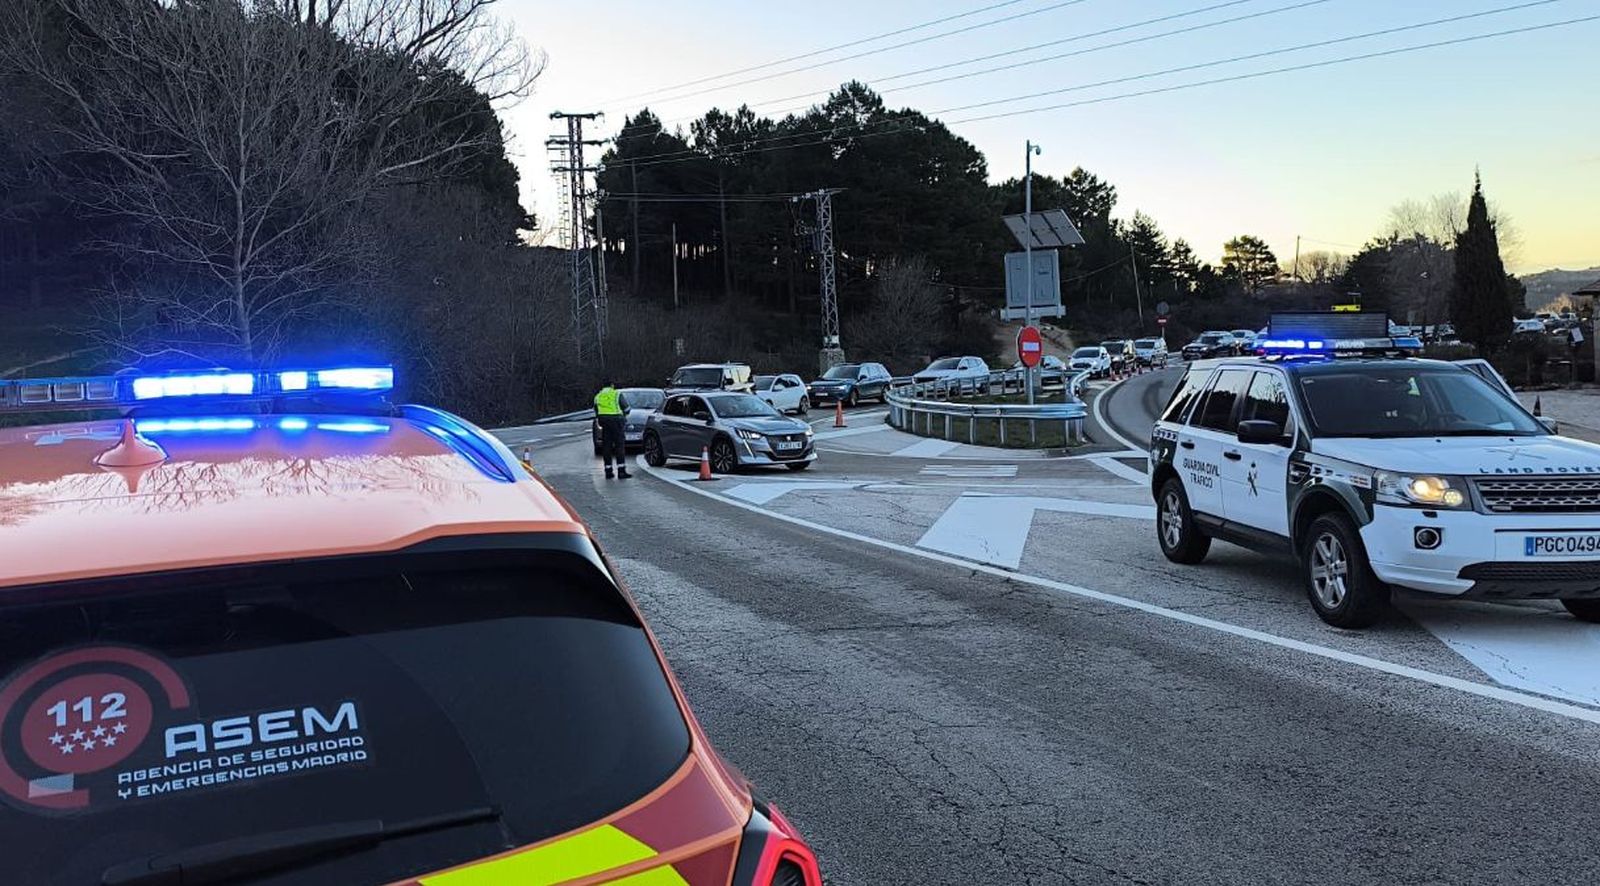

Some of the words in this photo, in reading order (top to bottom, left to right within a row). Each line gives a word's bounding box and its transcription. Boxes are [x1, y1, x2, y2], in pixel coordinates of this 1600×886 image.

[1183, 458, 1205, 472] GUARDIA
[1206, 463, 1220, 476] CIVIL
[1190, 473, 1212, 488] TRAFICO
[1535, 536, 1564, 553] PGC
[46, 692, 127, 727] 112
[164, 702, 359, 758] ASEM
[118, 757, 213, 785] AGENCIA
[218, 753, 246, 767] DE
[251, 736, 365, 762] SEGURIDAD
[118, 788, 129, 799] Y
[137, 763, 289, 797] EMERGENCIAS
[292, 750, 367, 770] MADRID
